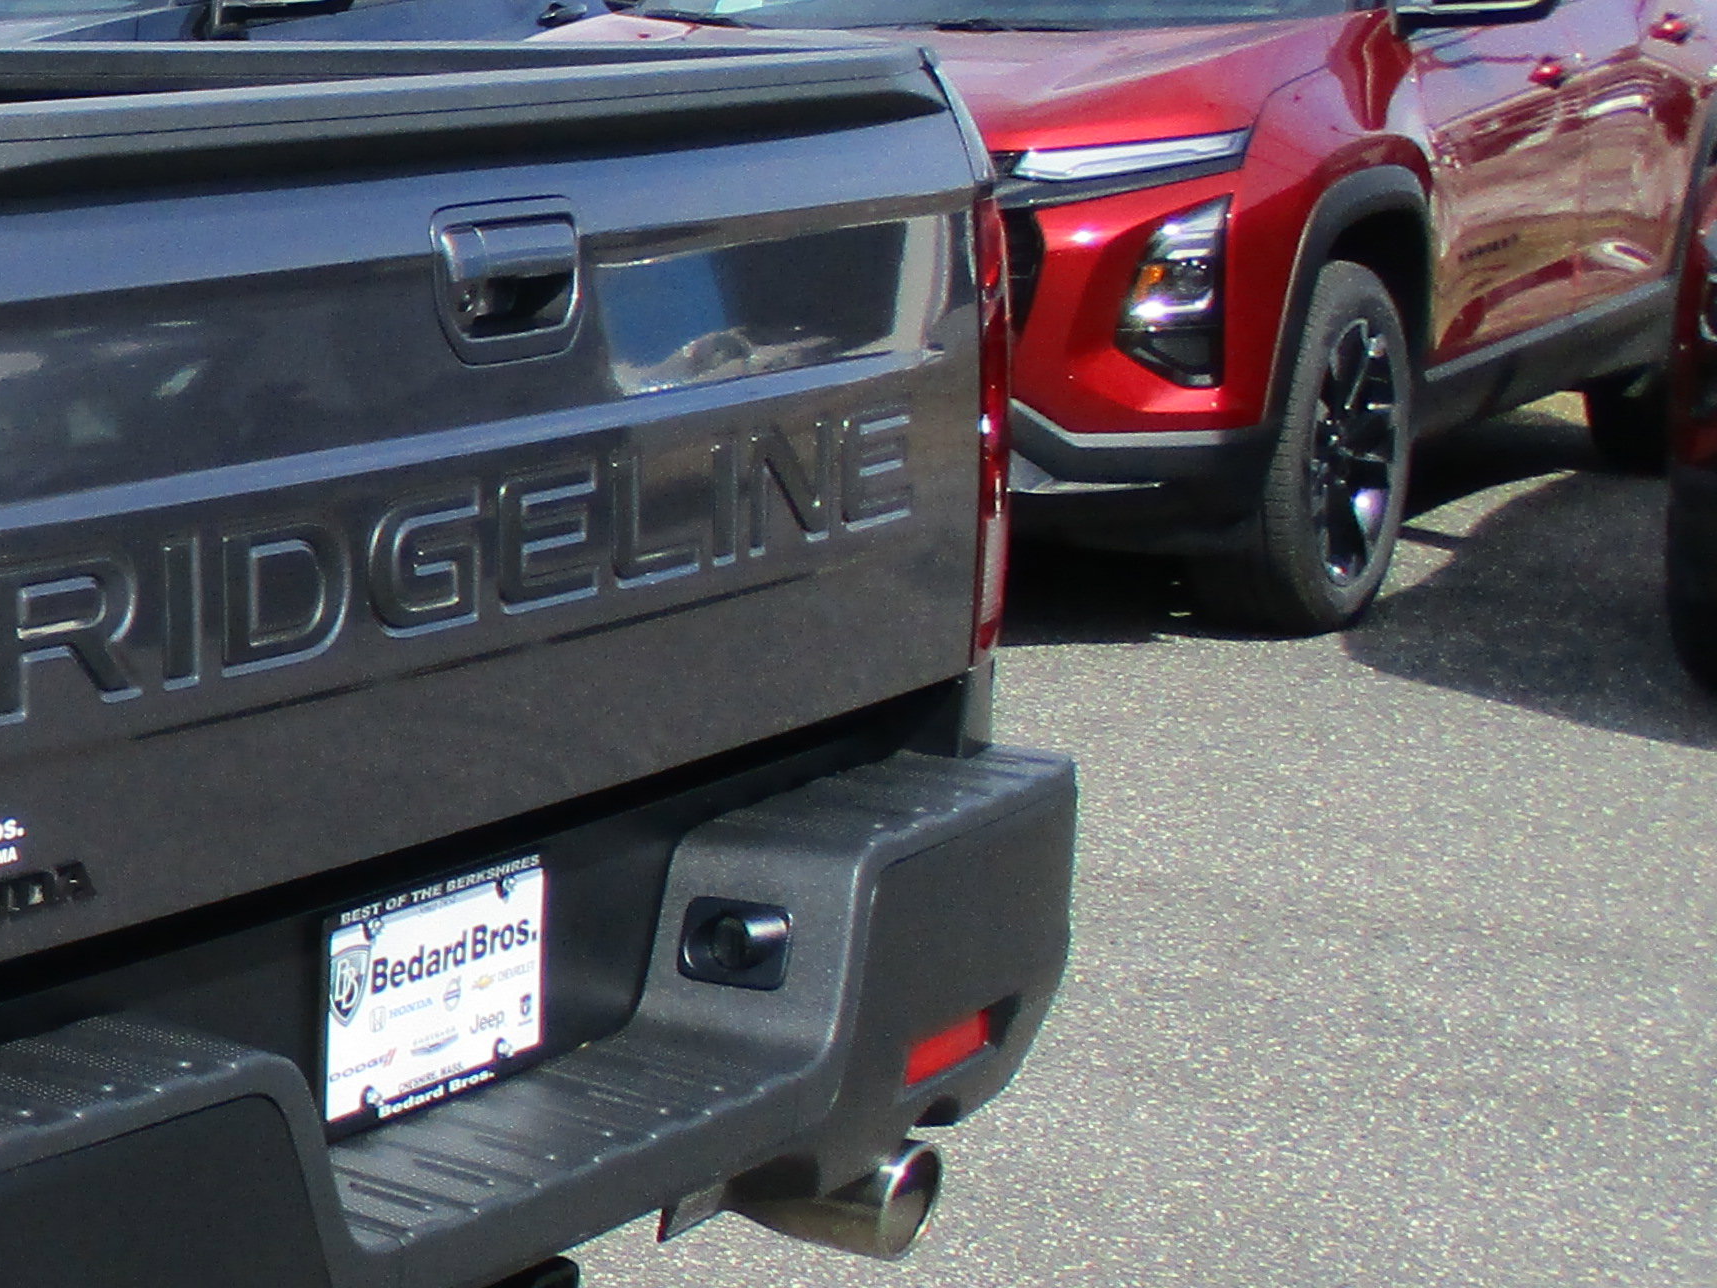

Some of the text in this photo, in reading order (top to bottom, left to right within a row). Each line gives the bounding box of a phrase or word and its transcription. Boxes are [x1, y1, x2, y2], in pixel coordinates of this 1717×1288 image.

[340, 903, 382, 925] BEST
[385, 893, 408, 910] OF
[411, 883, 443, 903] THE
[446, 853, 541, 892] BERKSHIRES
[371, 918, 538, 995] Bedard Bros.
[389, 997, 434, 1019] HONDA
[469, 1010, 505, 1035] Jeep
[329, 1054, 388, 1082] DODGE
[378, 1070, 496, 1119] Bedard Bros.
